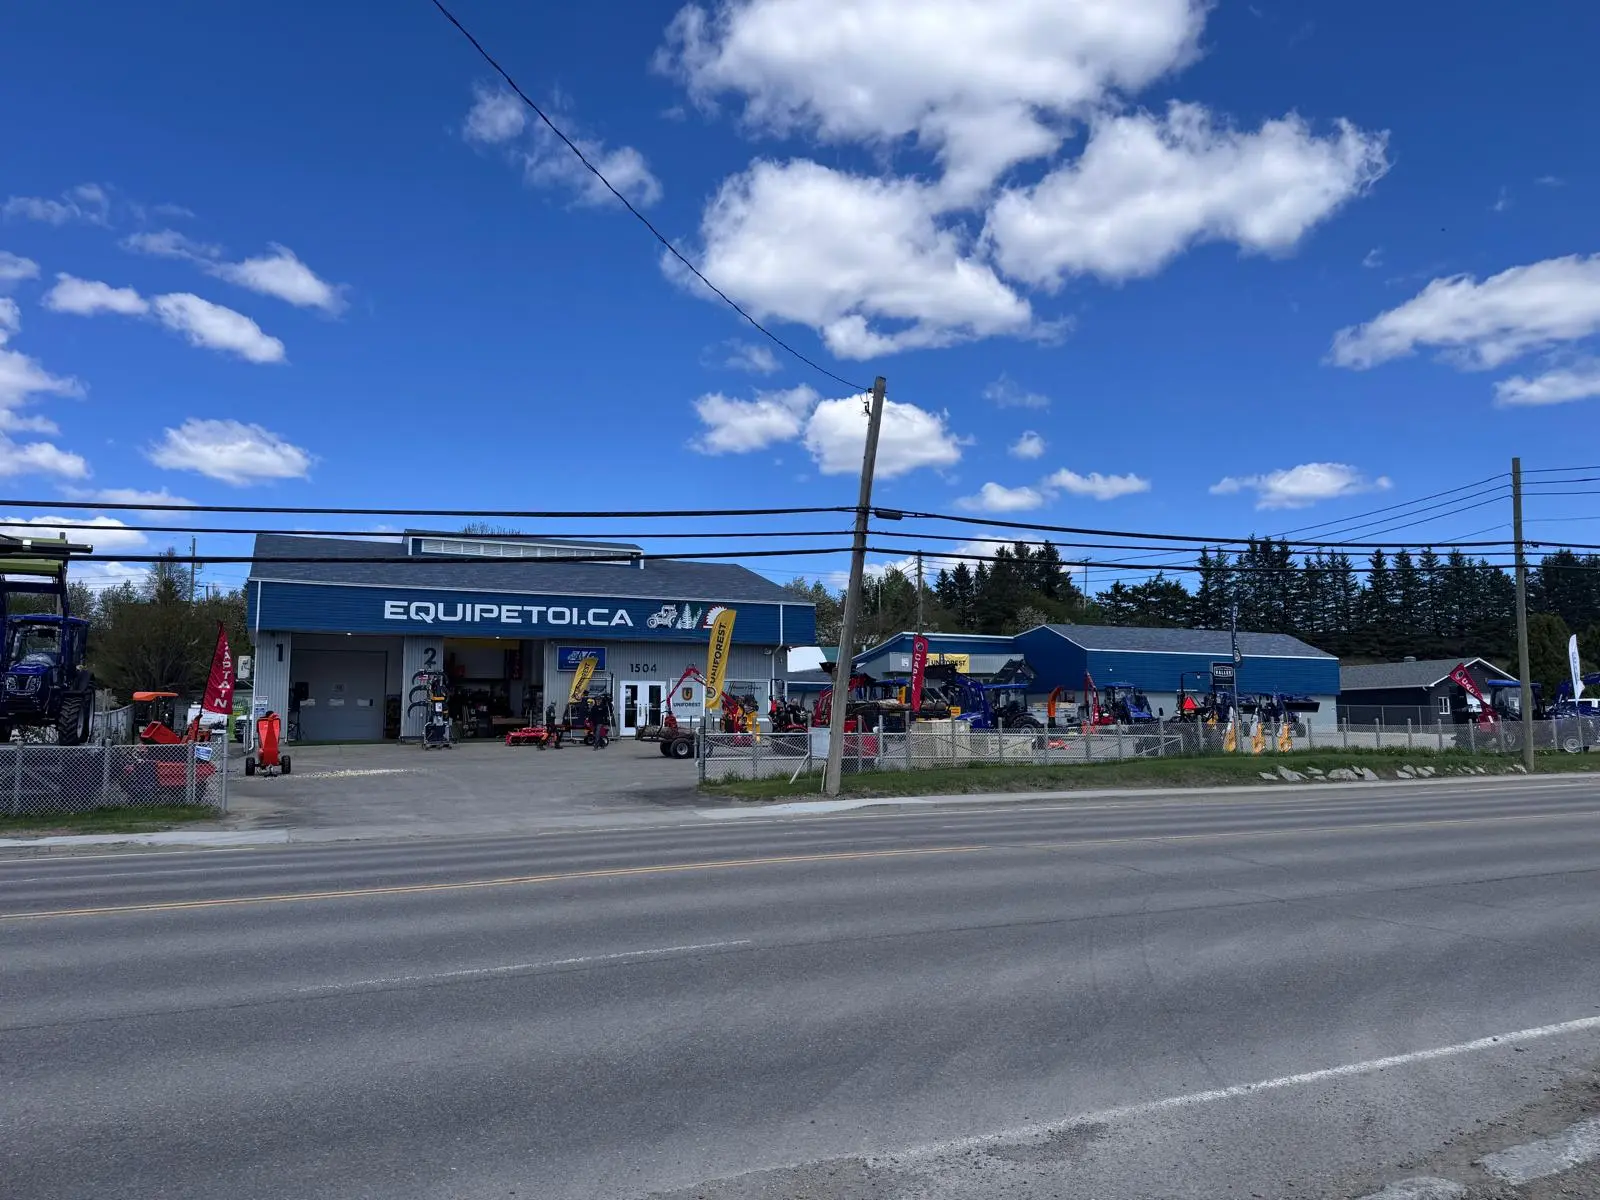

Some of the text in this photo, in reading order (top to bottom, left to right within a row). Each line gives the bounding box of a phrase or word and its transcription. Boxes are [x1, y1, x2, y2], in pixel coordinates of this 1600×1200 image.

[384, 600, 634, 627] EQUIPETOI.CA
[276, 643, 283, 662] 1
[424, 647, 437, 666] 2
[709, 622, 727, 684] UNIFOREST
[630, 663, 657, 673] 1504
